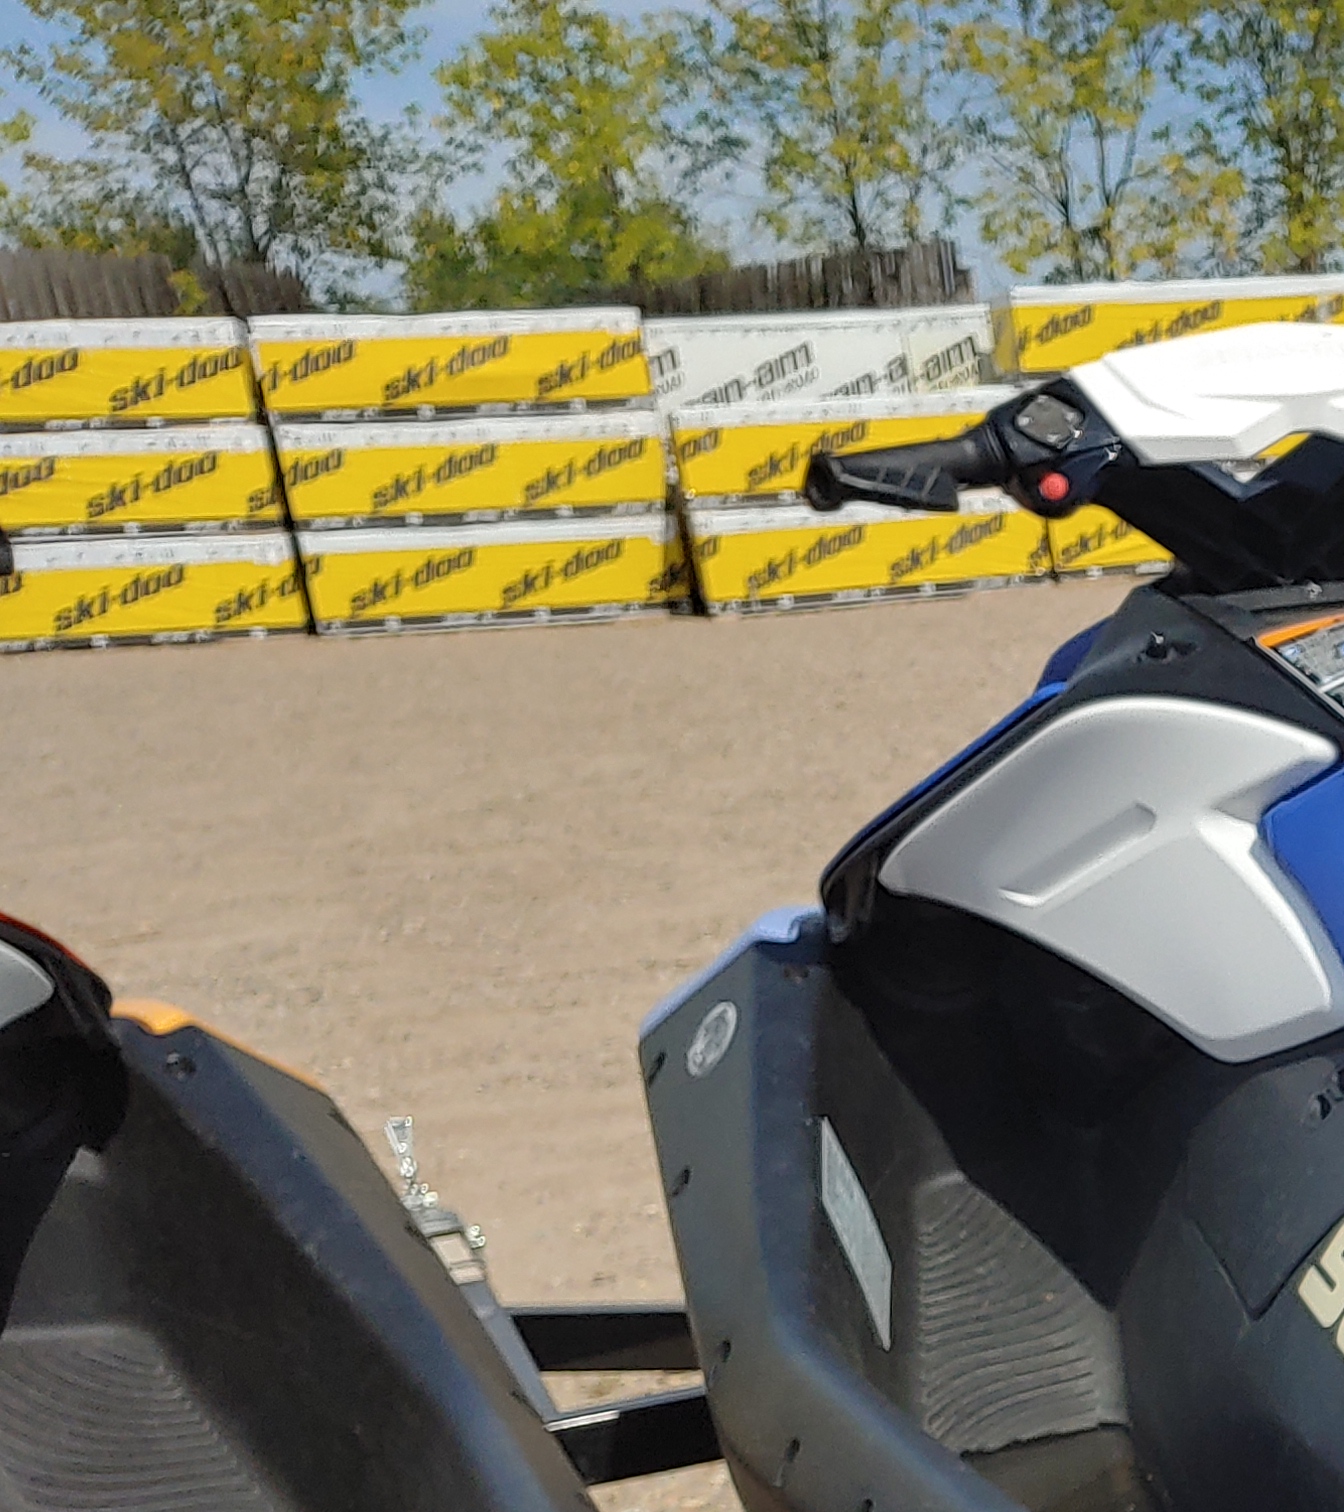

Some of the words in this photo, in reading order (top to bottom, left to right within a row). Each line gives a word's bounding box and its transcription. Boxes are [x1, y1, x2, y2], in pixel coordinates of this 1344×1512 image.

[108, 345, 243, 413] ski-doo
[381, 334, 512, 402] ski-doo
[86, 448, 219, 518] ski-doo
[371, 442, 499, 511] ski-doo
[523, 437, 648, 507] ski-doo
[53, 563, 185, 631] ski-doo
[350, 546, 478, 620] ski-doo
[500, 538, 625, 609] ski-doo
